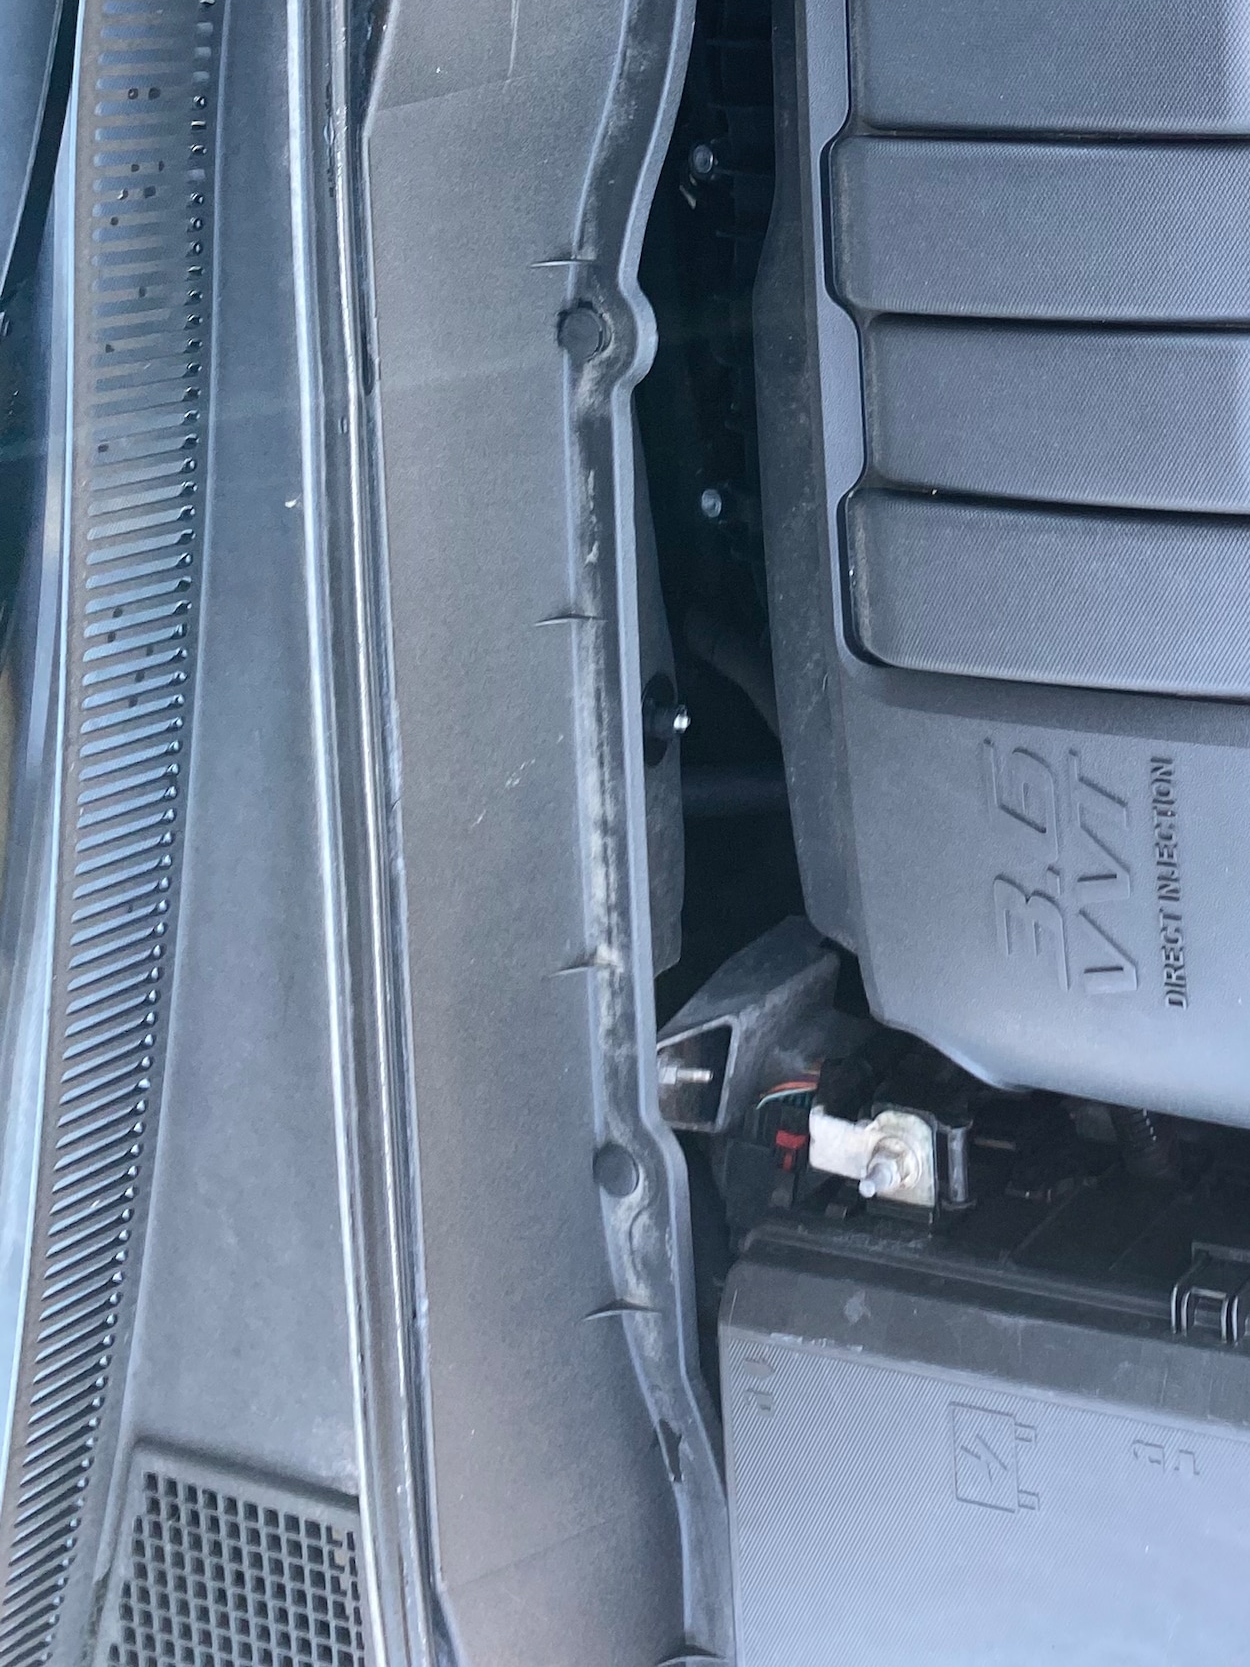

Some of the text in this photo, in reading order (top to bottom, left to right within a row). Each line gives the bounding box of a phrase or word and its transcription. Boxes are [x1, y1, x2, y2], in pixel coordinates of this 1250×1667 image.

[982, 736, 1069, 992] 3.6
[1069, 748, 1138, 994] VVT
[1150, 756, 1188, 1010] DIRECT INJECTION
